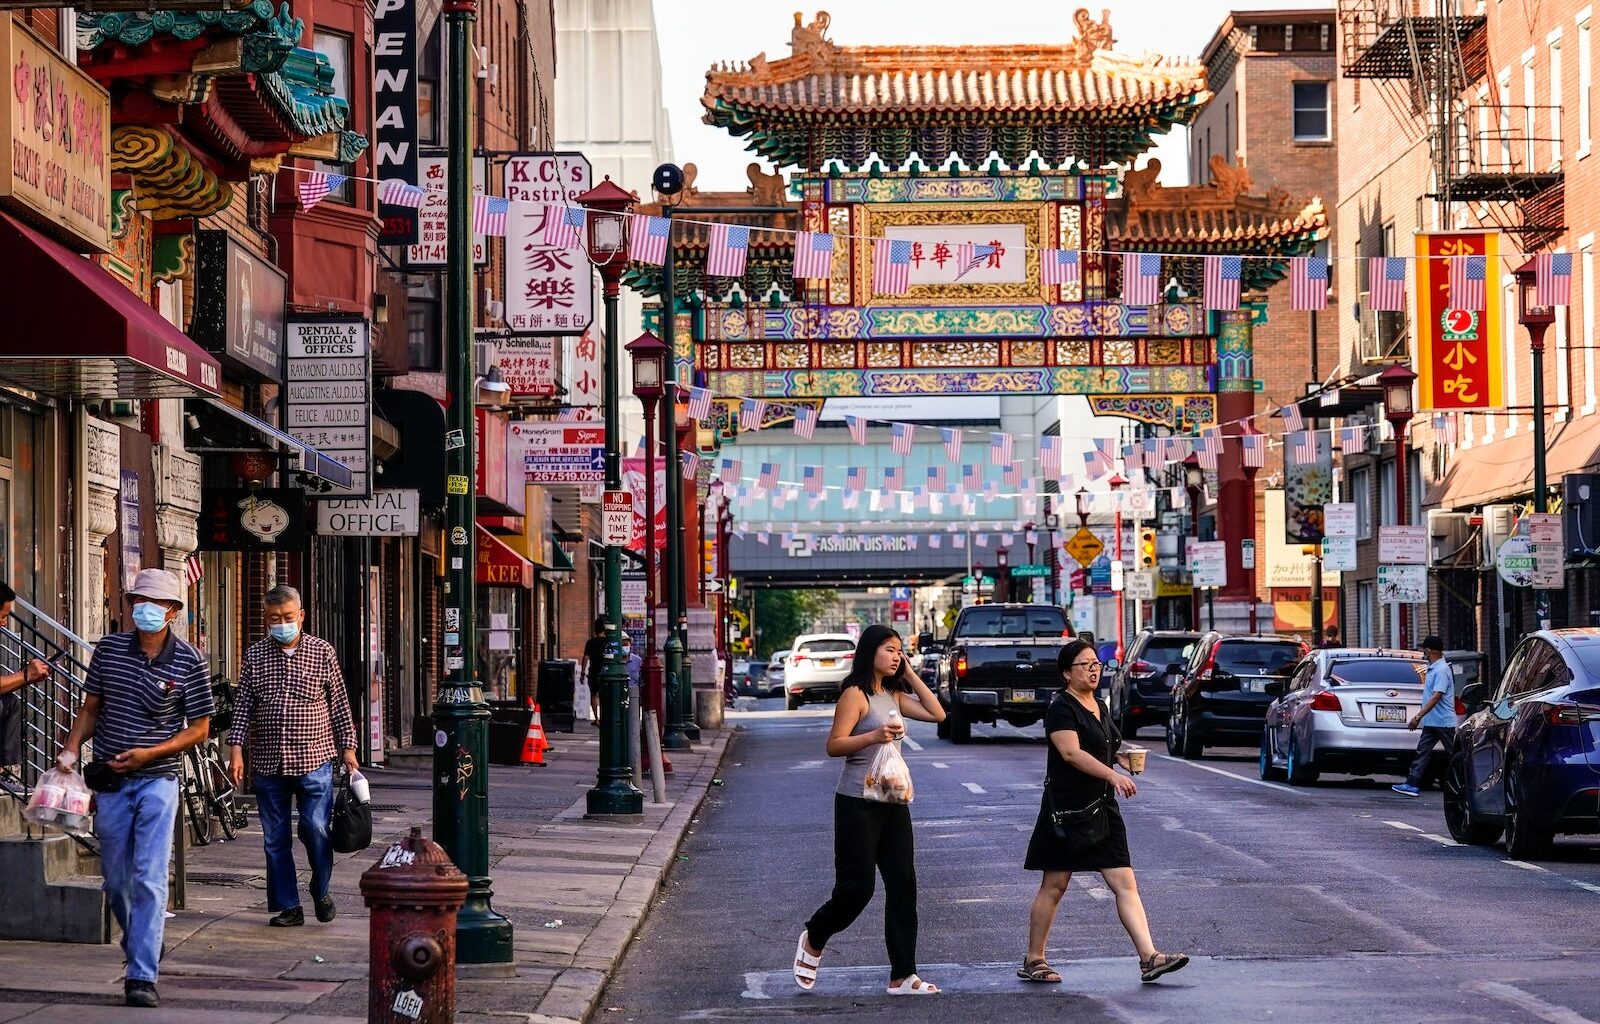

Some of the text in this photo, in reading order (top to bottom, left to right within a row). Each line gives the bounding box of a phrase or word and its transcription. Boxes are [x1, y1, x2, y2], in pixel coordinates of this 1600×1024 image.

[298, 326, 357, 335] DENTAL &
[302, 336, 356, 344] MEDICAL
[305, 345, 353, 354] OFFICES
[290, 364, 328, 377] RAYMOND
[289, 386, 330, 399] AUGUSTINE
[295, 410, 318, 422] FELICE
[522, 428, 562, 440] MoneyGram
[612, 493, 624, 503] NO
[604, 503, 632, 511] STOPPING
[330, 513, 400, 532] OFFICE
[608, 524, 627, 532] TIME
[1505, 559, 1532, 568] 92401
[487, 564, 520, 583] KEE
